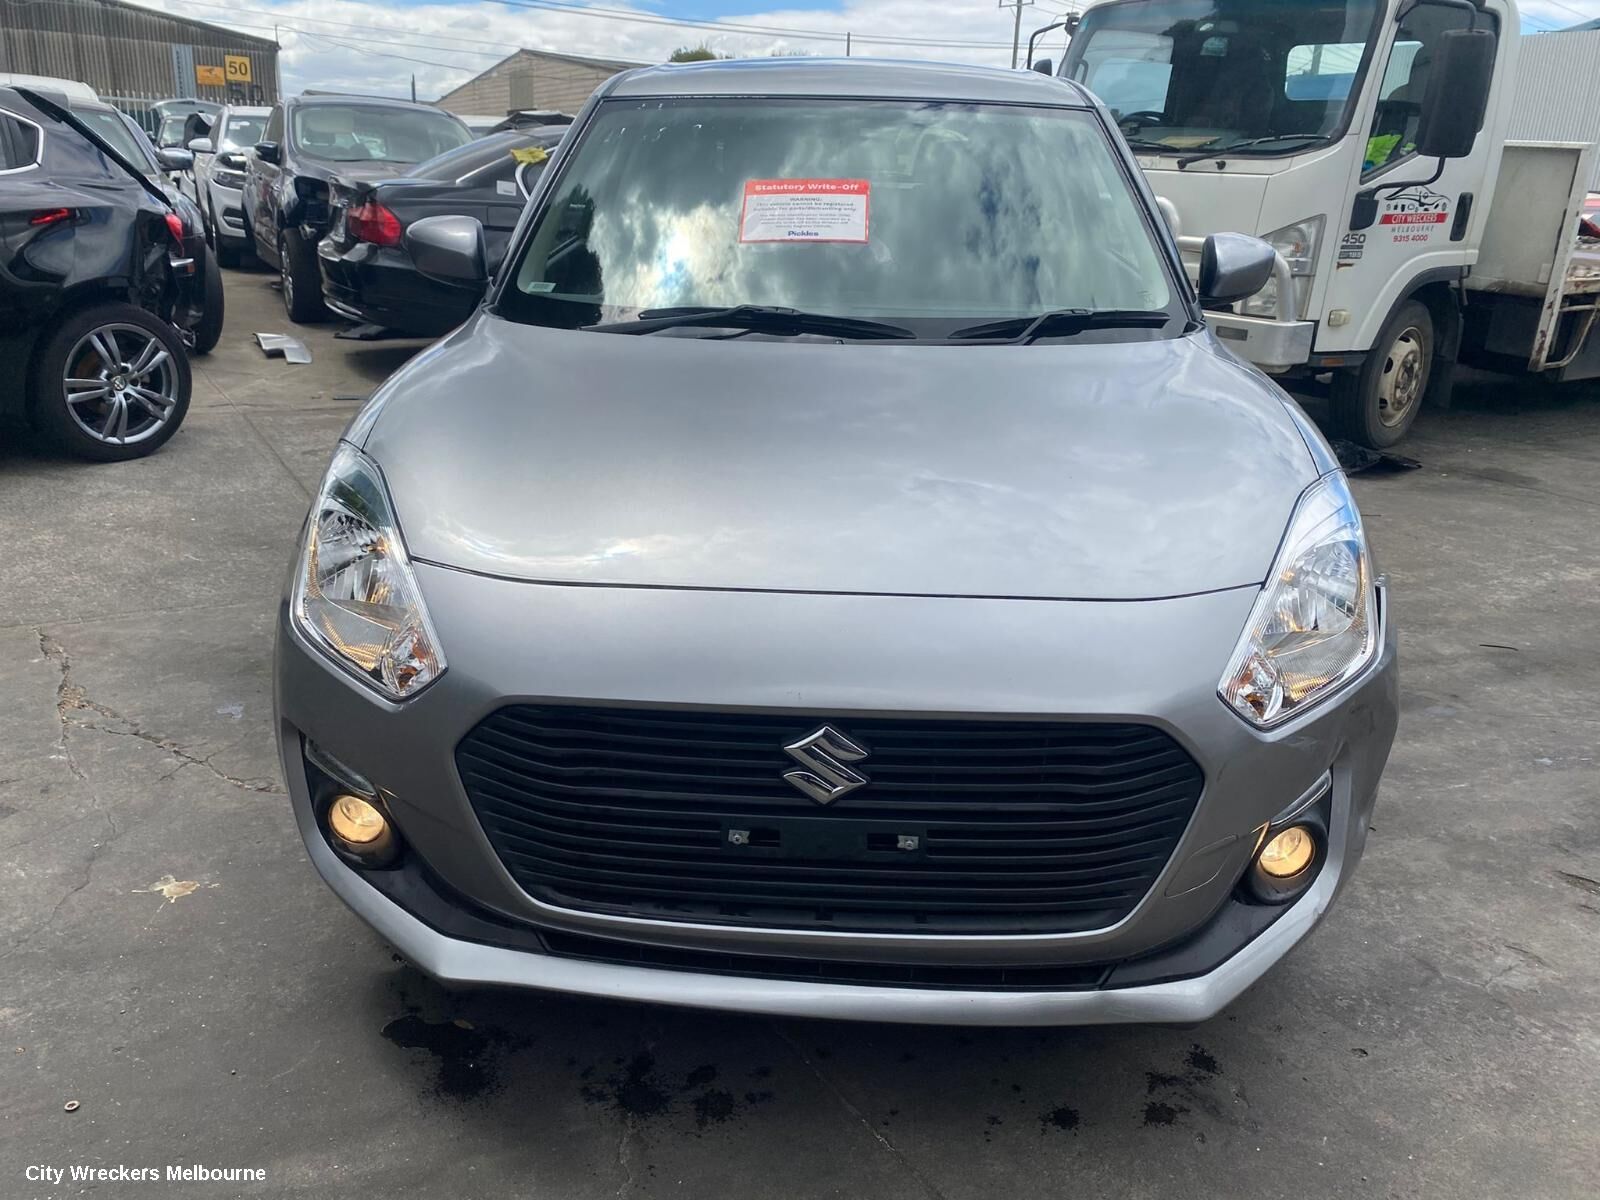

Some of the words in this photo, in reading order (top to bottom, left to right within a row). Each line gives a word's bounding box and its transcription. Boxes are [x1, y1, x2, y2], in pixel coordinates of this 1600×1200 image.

[228, 61, 249, 76] 50
[754, 183, 805, 191] Statutory
[1391, 214, 1407, 224] CITY
[1341, 233, 1367, 244] 450
[1393, 234, 1410, 243] 9315
[1411, 234, 1429, 242] 4000
